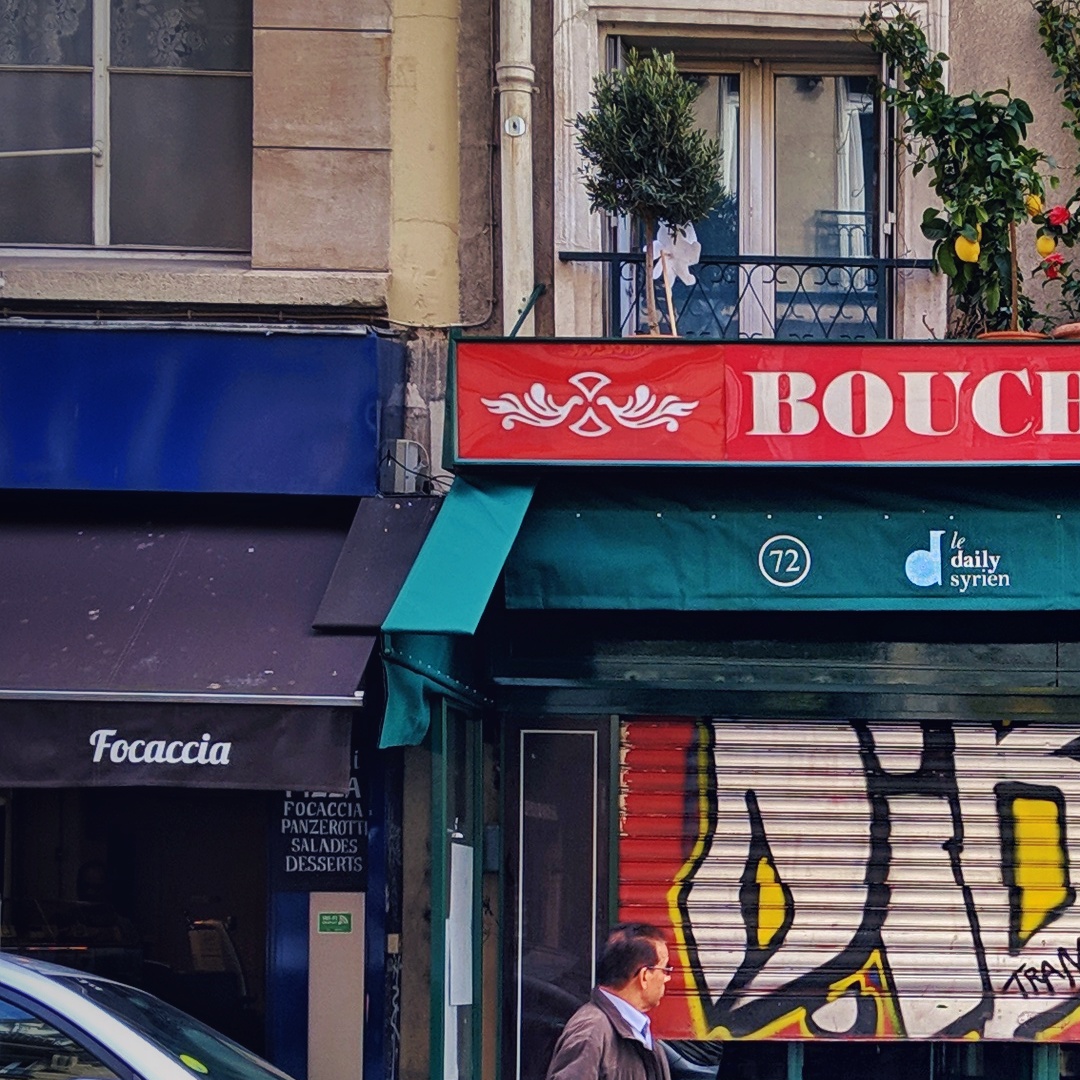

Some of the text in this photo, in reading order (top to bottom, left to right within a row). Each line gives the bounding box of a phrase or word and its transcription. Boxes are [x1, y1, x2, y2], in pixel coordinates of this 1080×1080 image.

[950, 531, 965, 550] le
[769, 549, 801, 573] 72
[950, 549, 1001, 573] daily
[950, 568, 1011, 593] syrien
[89, 729, 232, 765] Focaccia
[283, 801, 363, 818] FOCACCIA
[281, 819, 368, 836] PANZEROTTI
[291, 838, 358, 854] SALADES
[285, 855, 363, 872] DESSERTS
